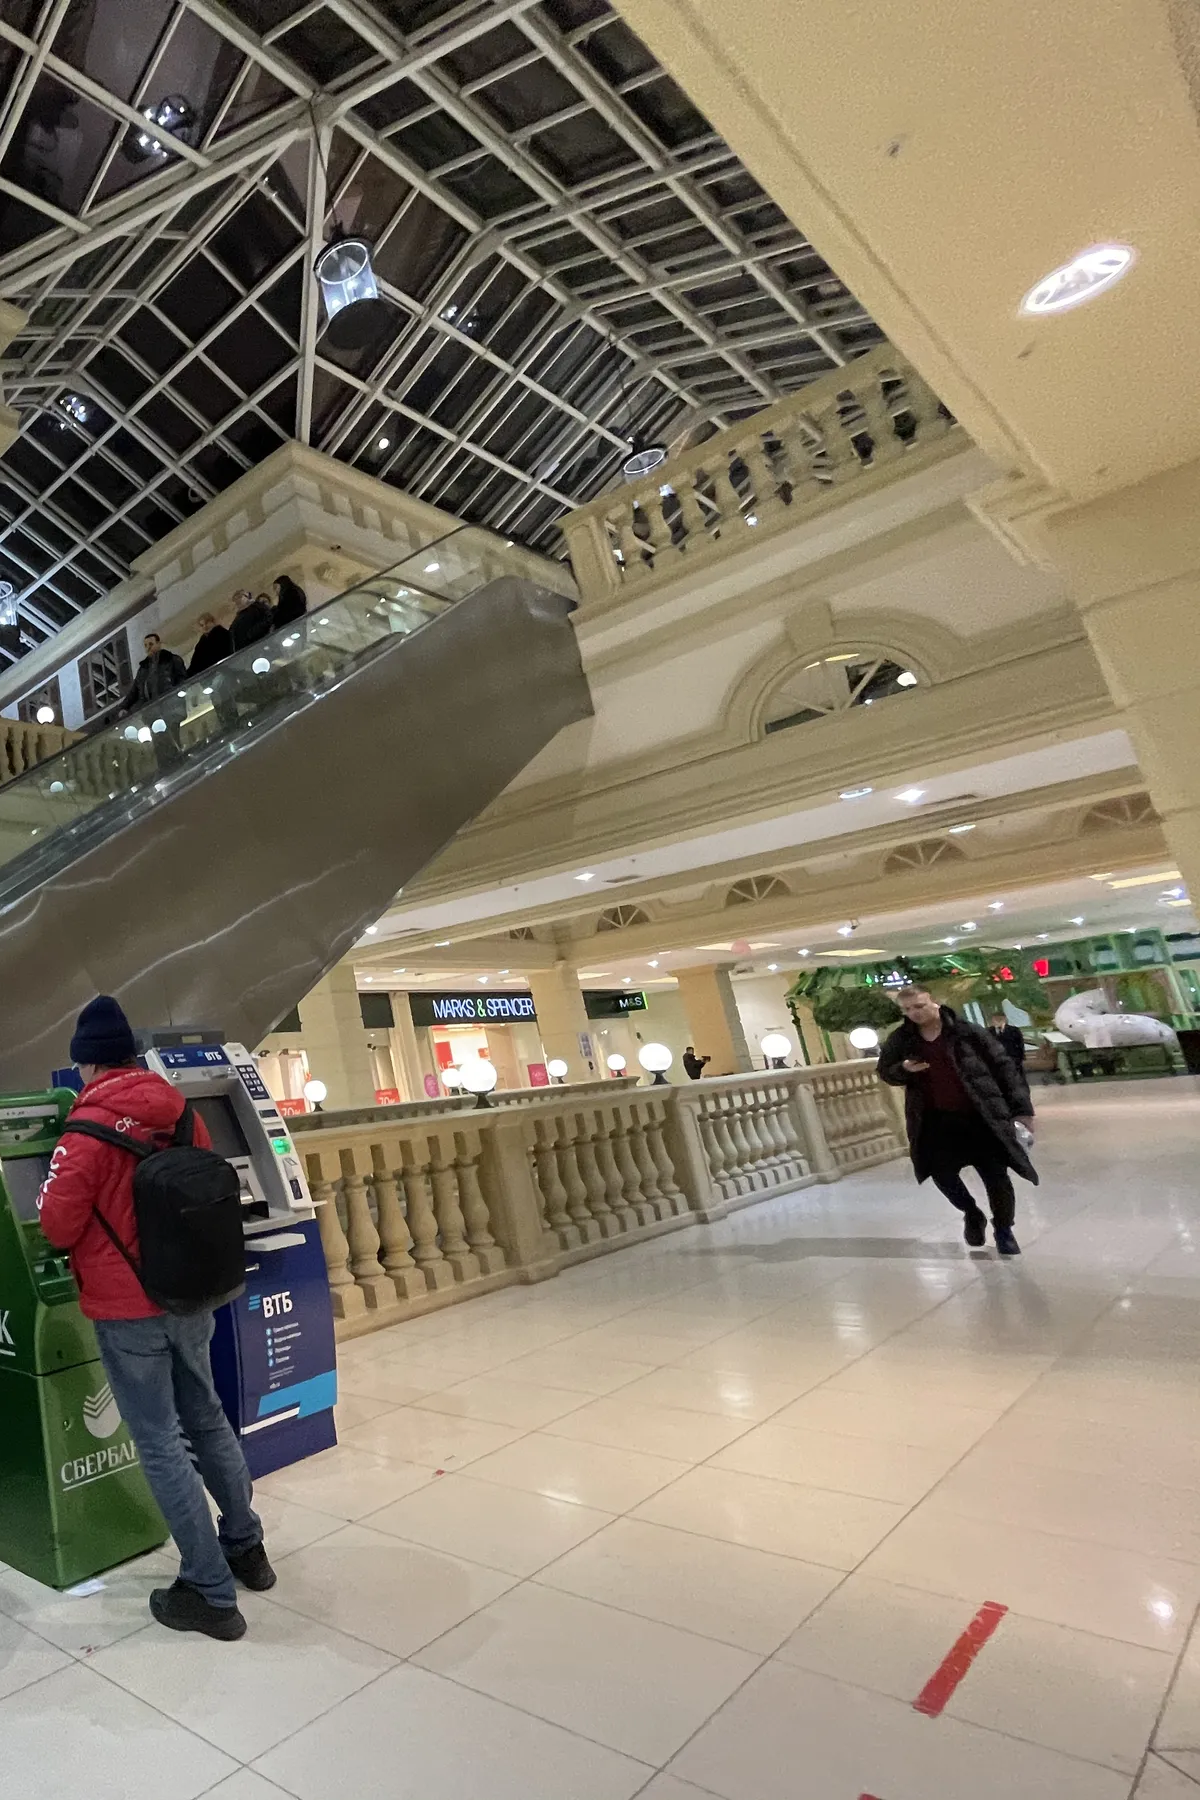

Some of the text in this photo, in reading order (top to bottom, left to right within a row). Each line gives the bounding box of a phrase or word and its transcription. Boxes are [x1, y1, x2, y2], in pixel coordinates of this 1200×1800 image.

[432, 998, 535, 1018] MARKS & SPENCER
[619, 996, 643, 1008] M&S
[204, 1051, 222, 1061] ВТБ
[262, 1291, 293, 1318] ВТБ
[61, 1440, 137, 1484] СБЕРБАН
